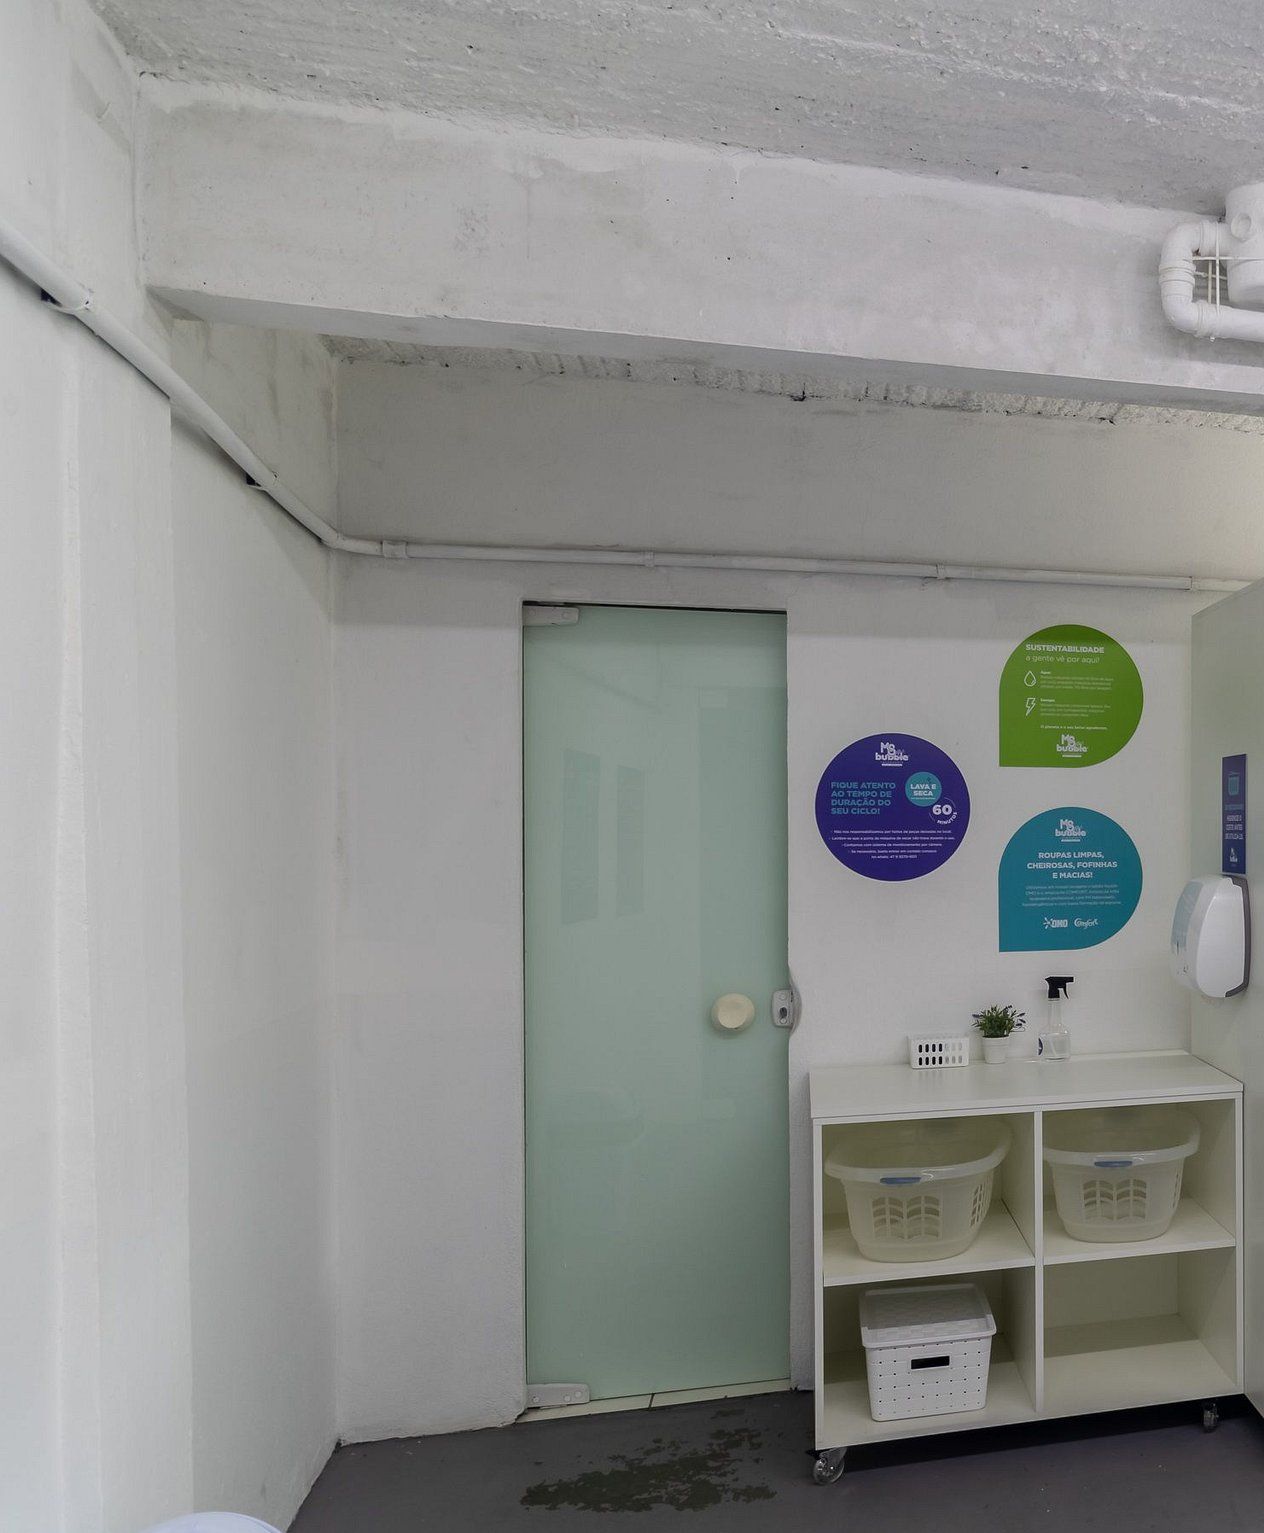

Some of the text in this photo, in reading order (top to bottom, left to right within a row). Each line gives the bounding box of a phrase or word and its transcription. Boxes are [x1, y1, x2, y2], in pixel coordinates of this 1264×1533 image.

[1026, 644, 1104, 653] SUSTENTABILIDADE
[1057, 743, 1087, 752] bubble
[875, 752, 909, 761] bubble
[831, 798, 876, 807] DURAÇÃO
[932, 804, 952, 815] 60
[1055, 829, 1086, 837] bubble
[1073, 851, 1104, 859] LIMPAS,
[1051, 919, 1068, 928] OMO
